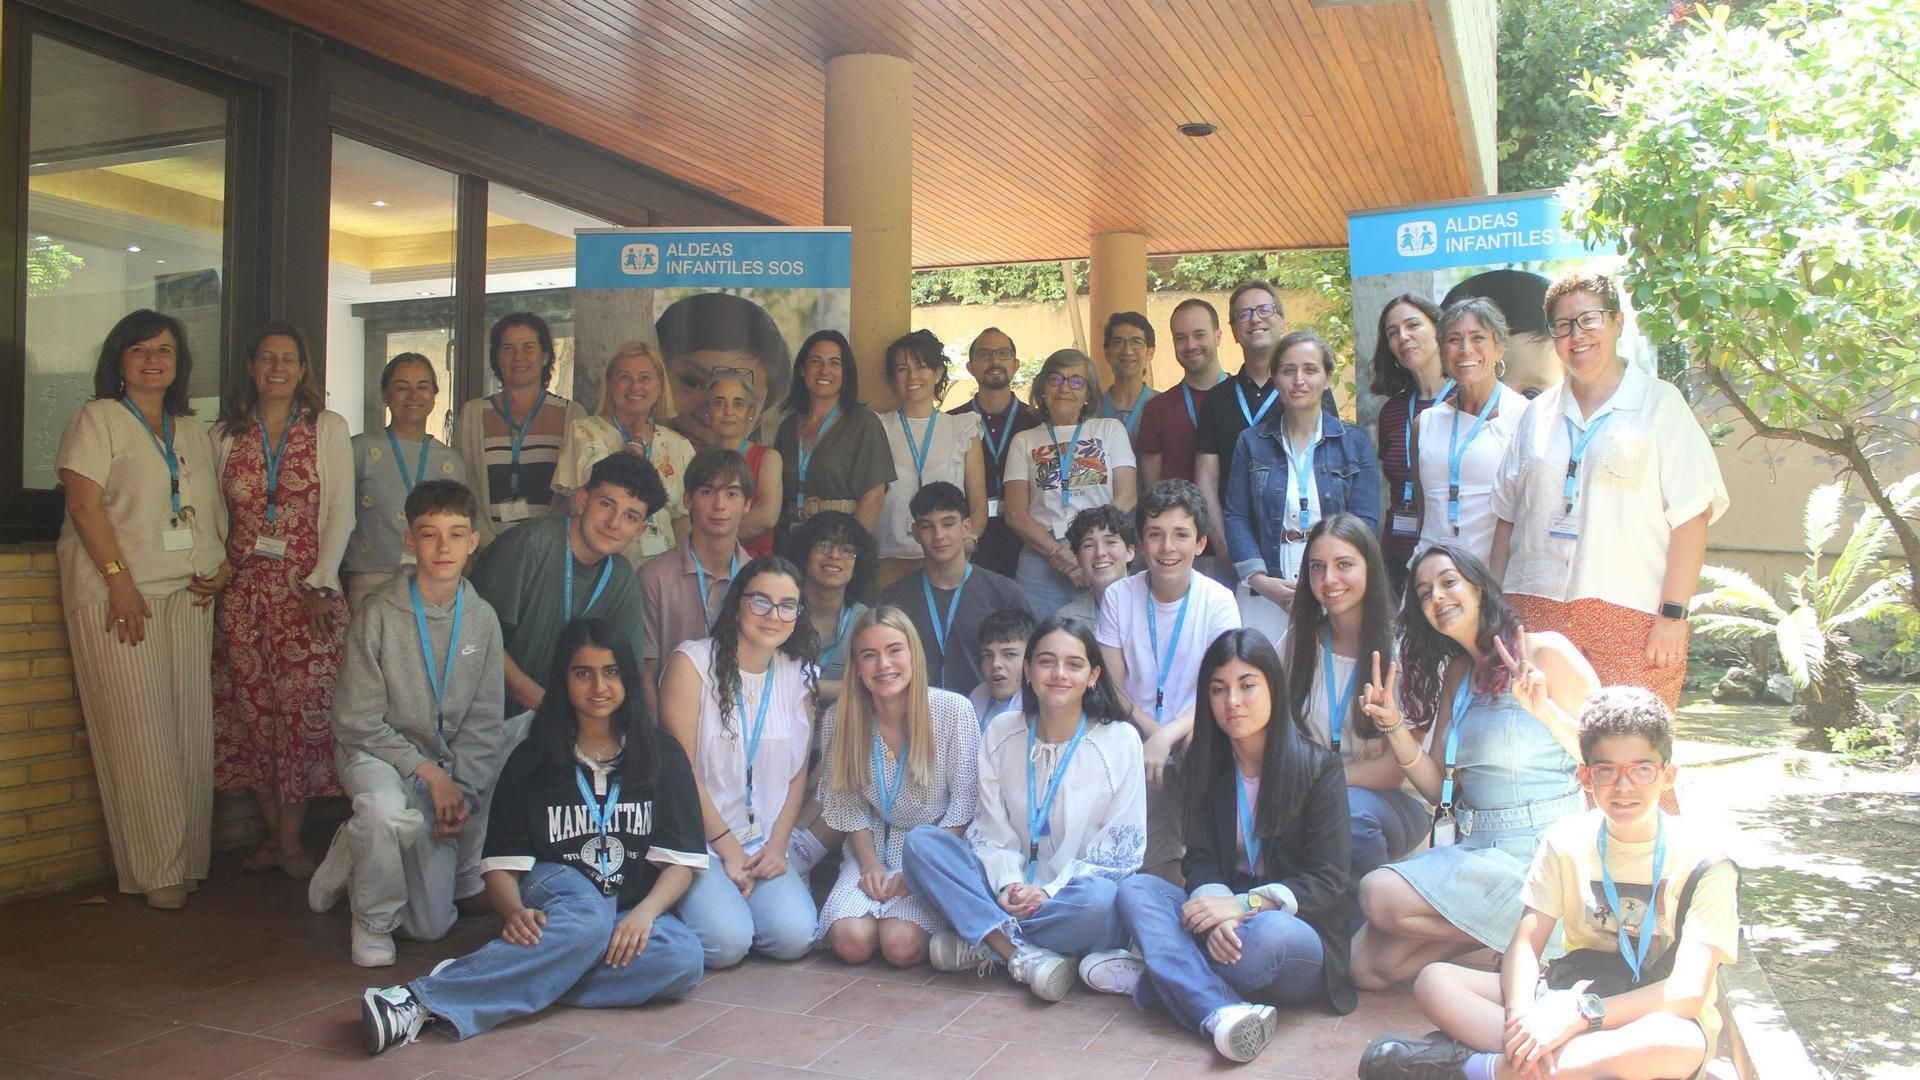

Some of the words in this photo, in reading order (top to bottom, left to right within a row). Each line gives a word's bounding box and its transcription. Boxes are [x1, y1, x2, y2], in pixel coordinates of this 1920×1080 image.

[1445, 211, 1518, 232] ALDEAS
[666, 242, 734, 257] ALDEAS
[1446, 228, 1553, 253] INFANTILES
[666, 260, 764, 275] INFANTILES
[768, 260, 804, 275] SOS
